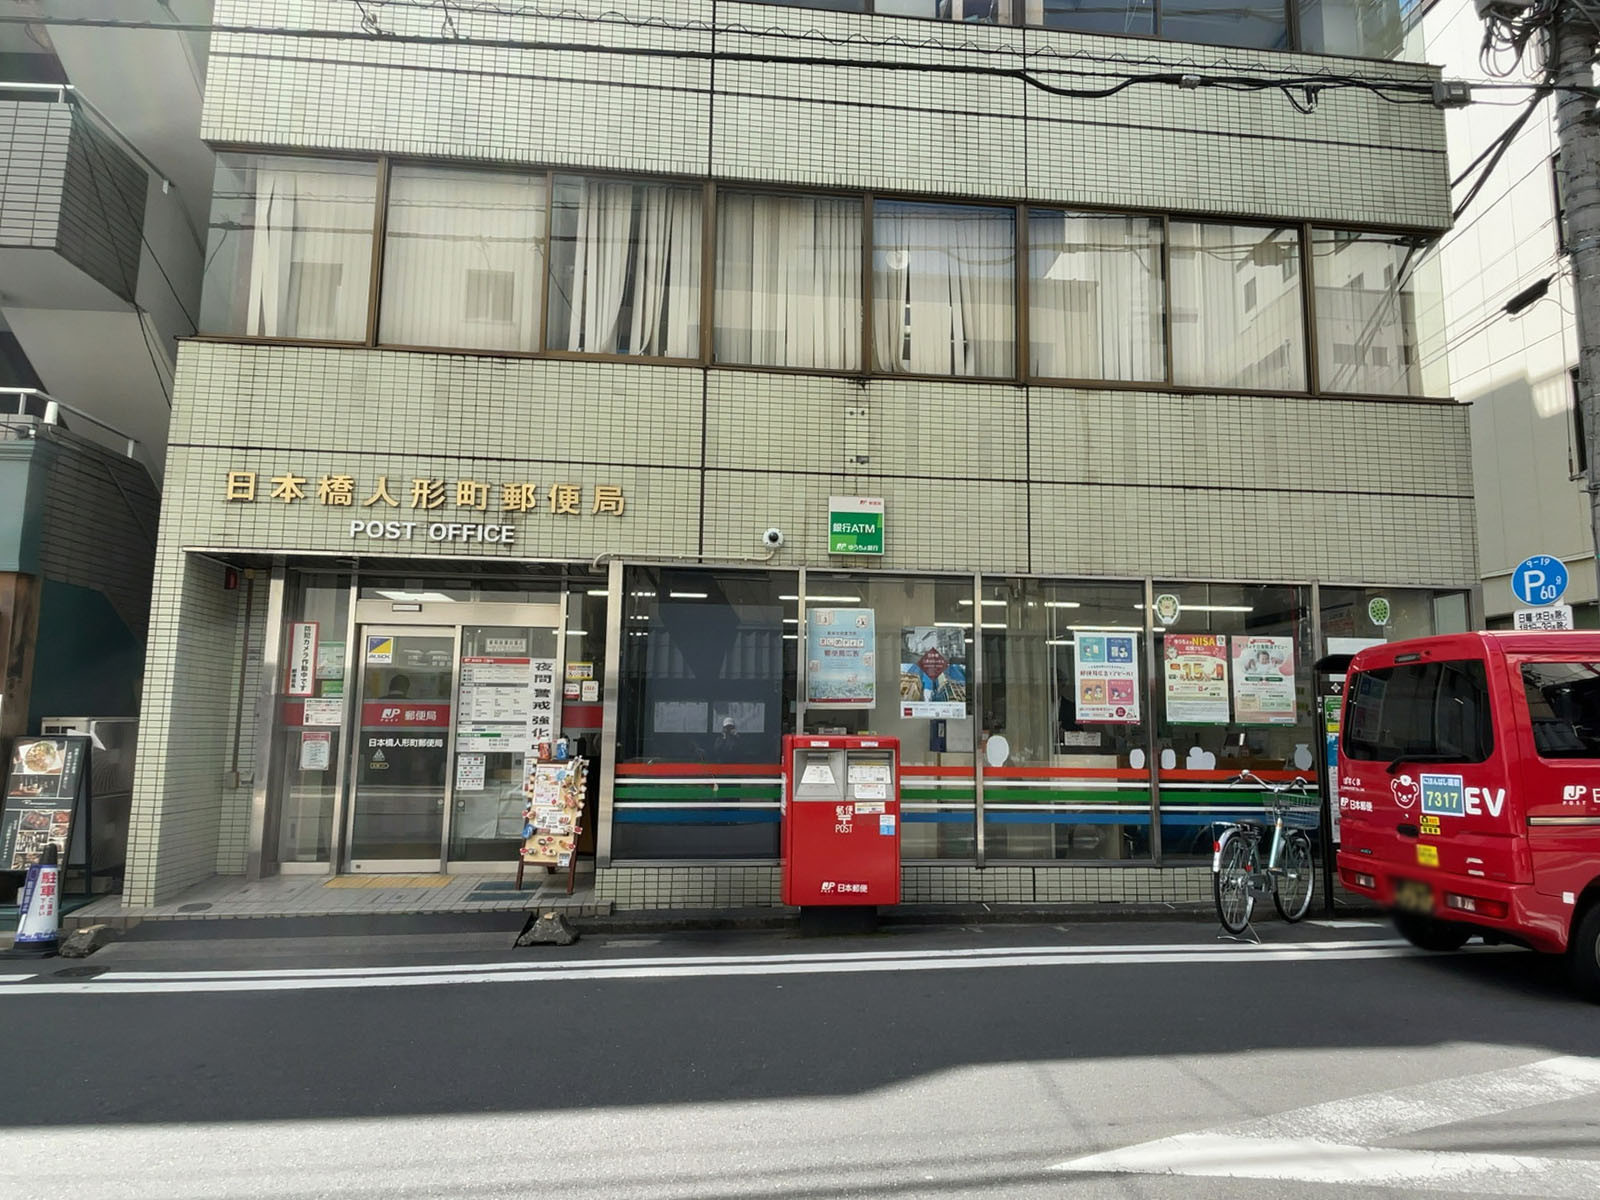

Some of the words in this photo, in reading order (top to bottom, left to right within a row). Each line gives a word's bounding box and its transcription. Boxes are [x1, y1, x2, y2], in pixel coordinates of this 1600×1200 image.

[225, 471, 626, 517] 日本橋人形町郵便局
[349, 520, 417, 541] POST
[428, 522, 516, 544] OFFICE
[833, 522, 876, 533] 銀行ATM
[1526, 557, 1550, 568] 9-19
[1523, 569, 1545, 602] P
[1540, 584, 1556, 600] 60
[404, 710, 437, 721] 郵便局
[368, 738, 444, 748] 日本橋人形町郵便局
[1426, 791, 1458, 808] 7317
[1464, 787, 1506, 817] EV
[835, 805, 854, 816] 郵便
[1350, 800, 1374, 813] 日本郵便
[835, 824, 853, 834] POST
[40, 872, 56, 897] 駐車
[837, 883, 869, 893] 日本郵便
